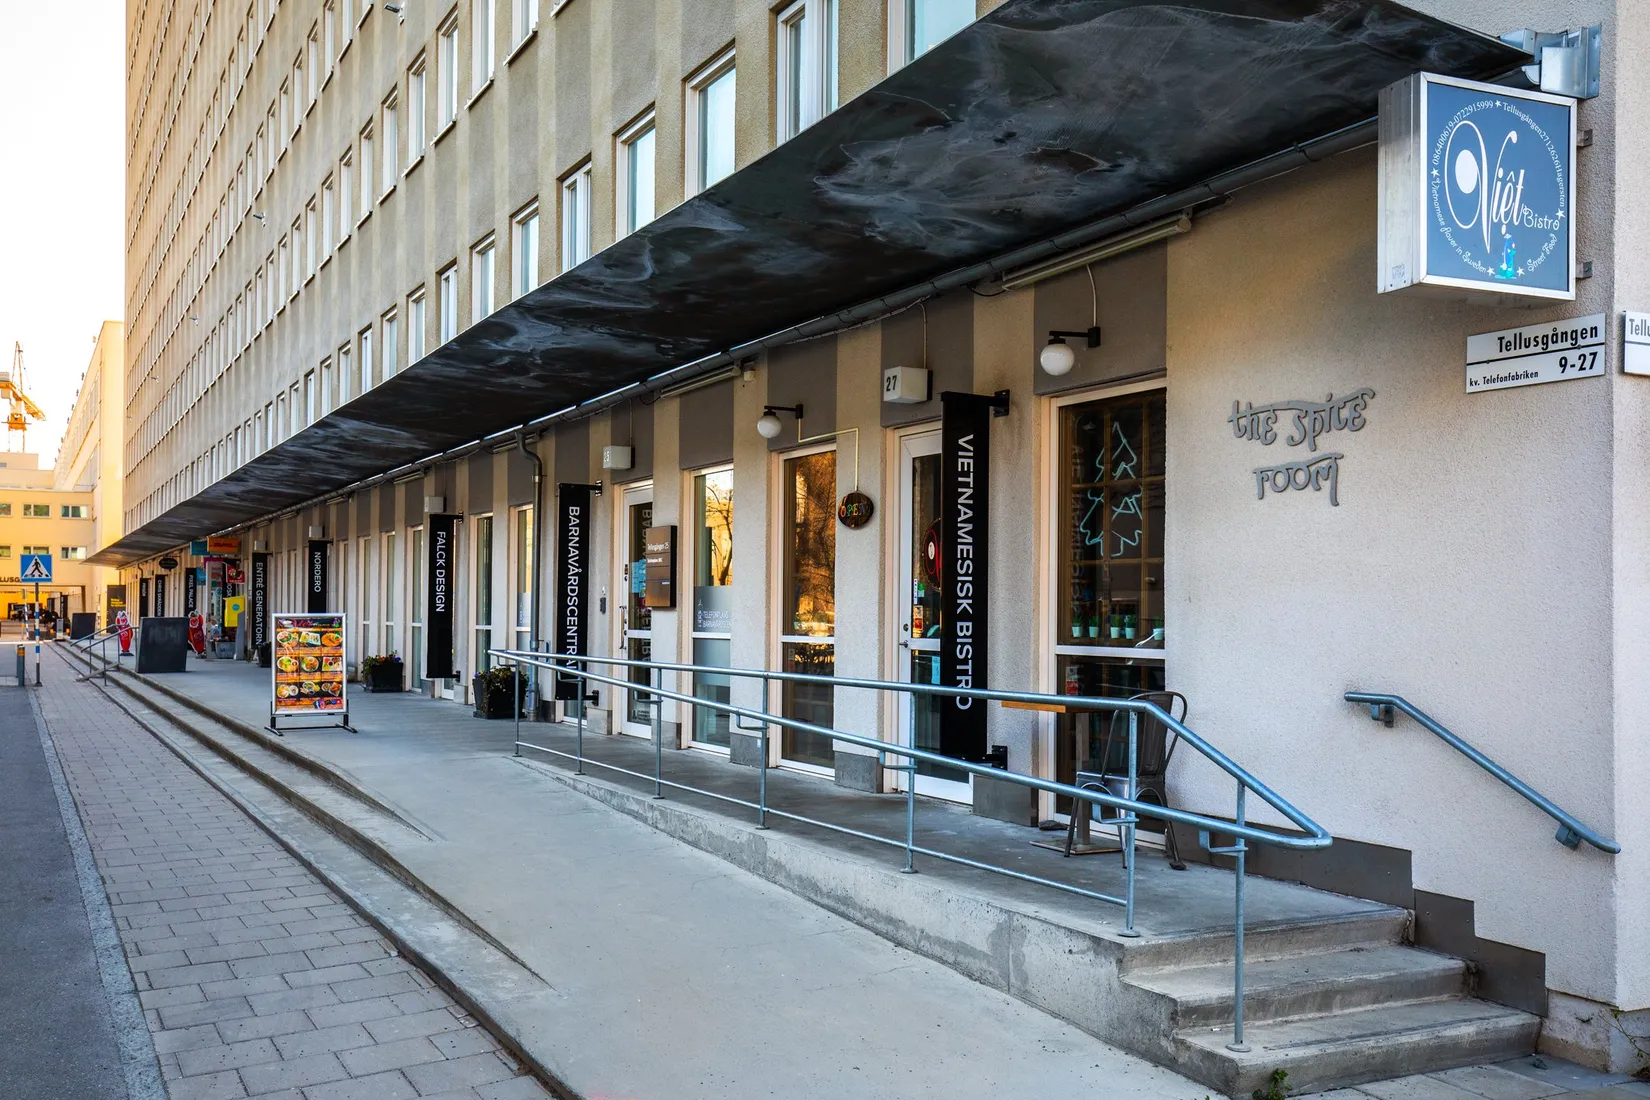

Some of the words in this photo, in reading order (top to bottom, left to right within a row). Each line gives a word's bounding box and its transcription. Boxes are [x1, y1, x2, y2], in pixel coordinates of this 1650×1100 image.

[1431, 177, 1446, 227] Vietnamese
[1462, 251, 1487, 273] Sweden
[1523, 204, 1560, 231] Bistro
[1527, 252, 1546, 272] Street
[1498, 325, 1598, 353] Tellusgången
[1470, 378, 1480, 387] kv.
[1483, 370, 1539, 385] Telefonfabriken
[1558, 352, 1598, 374] 9-27
[886, 375, 898, 392] 27
[956, 433, 974, 615] VIETNAMESISK
[436, 531, 446, 567] FALCK
[256, 562, 265, 589] ENTRÉ
[314, 551, 322, 593] NORDERO
[435, 569, 445, 612] DESIGN
[255, 589, 263, 645] GENERATORN
[956, 621, 973, 710] BISTRO
